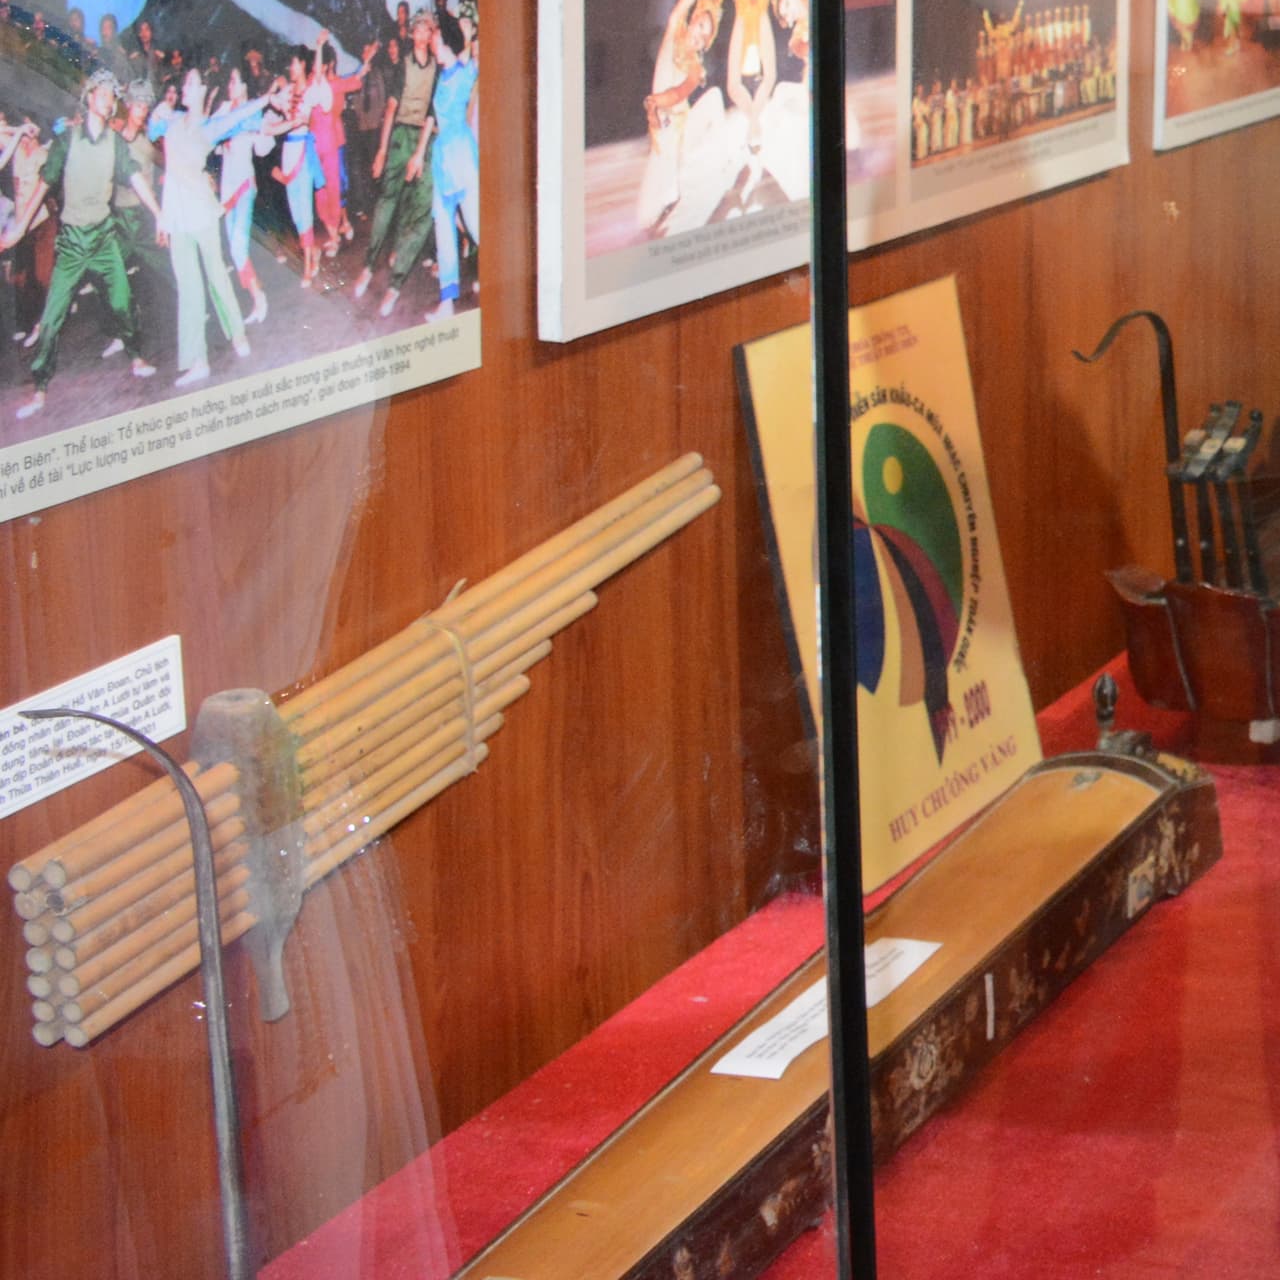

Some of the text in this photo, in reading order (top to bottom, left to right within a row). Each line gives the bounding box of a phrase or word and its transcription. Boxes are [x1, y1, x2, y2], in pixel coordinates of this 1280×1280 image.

[0, 460, 20, 478] iện
[64, 434, 88, 458] Thể
[135, 418, 164, 435] khúc
[147, 435, 176, 454] trang
